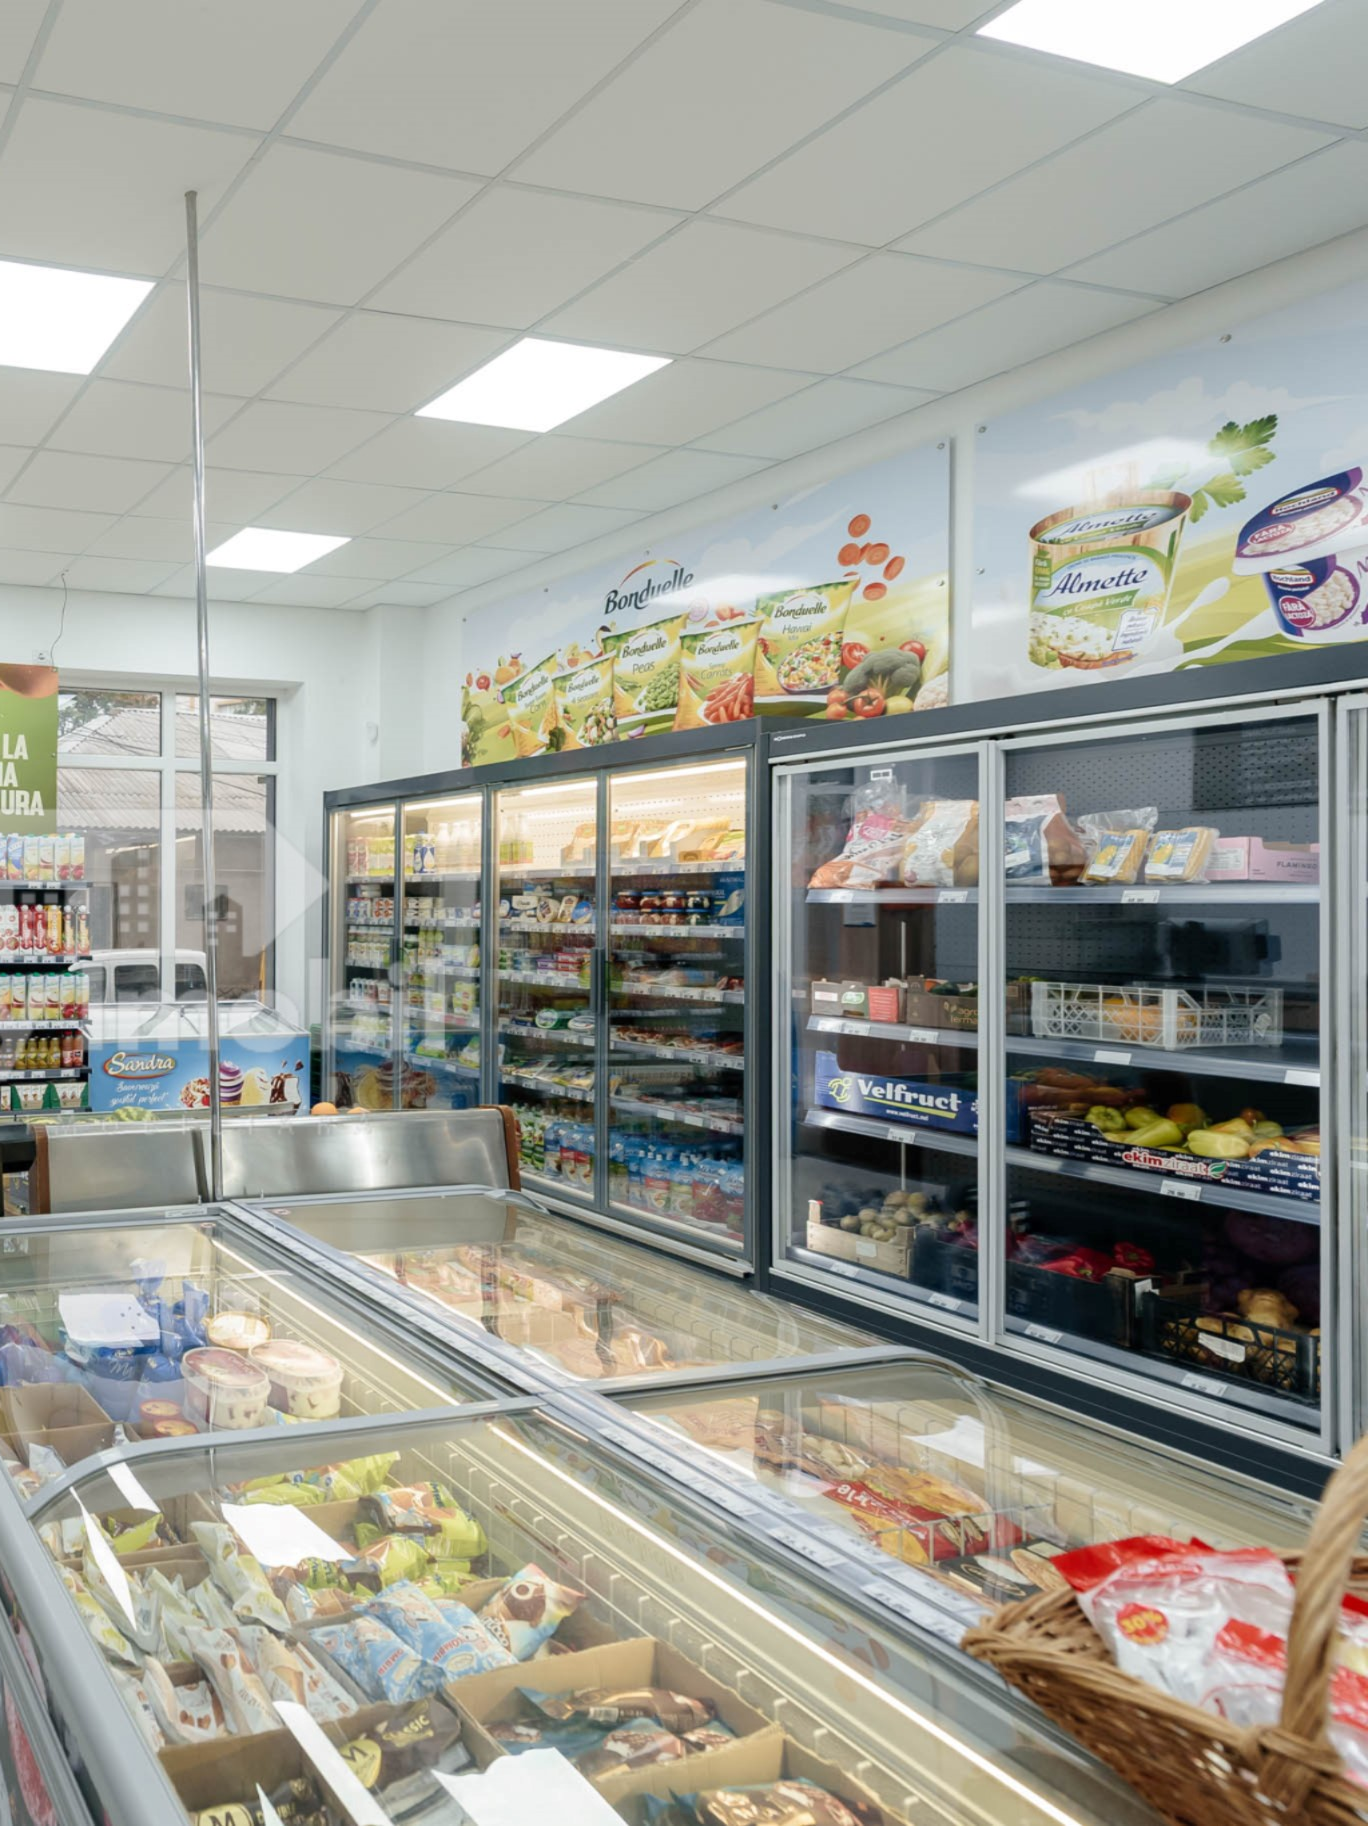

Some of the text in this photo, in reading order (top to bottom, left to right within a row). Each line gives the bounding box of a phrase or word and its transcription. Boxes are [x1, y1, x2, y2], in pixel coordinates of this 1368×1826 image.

[1275, 491, 1336, 513] Hochland
[1057, 512, 1157, 537] Almette
[604, 567, 694, 615] Bonduelle
[1041, 568, 1148, 598] Almette
[775, 602, 828, 620] Bonduelle
[622, 637, 668, 659] Bonduelle
[698, 638, 740, 656] Bonduelle
[632, 660, 655, 675] Peas
[517, 675, 550, 702] Bonduelle
[567, 675, 600, 693] Bonduelle
[2, 733, 29, 760] LA
[1276, 860, 1318, 870] FLAMINGO
[108, 1051, 174, 1075] Sandra
[858, 1078, 962, 1112] Velfruct
[1123, 1151, 1206, 1175] ekimziraat
[1120, 1612, 1165, 1635] 30%
